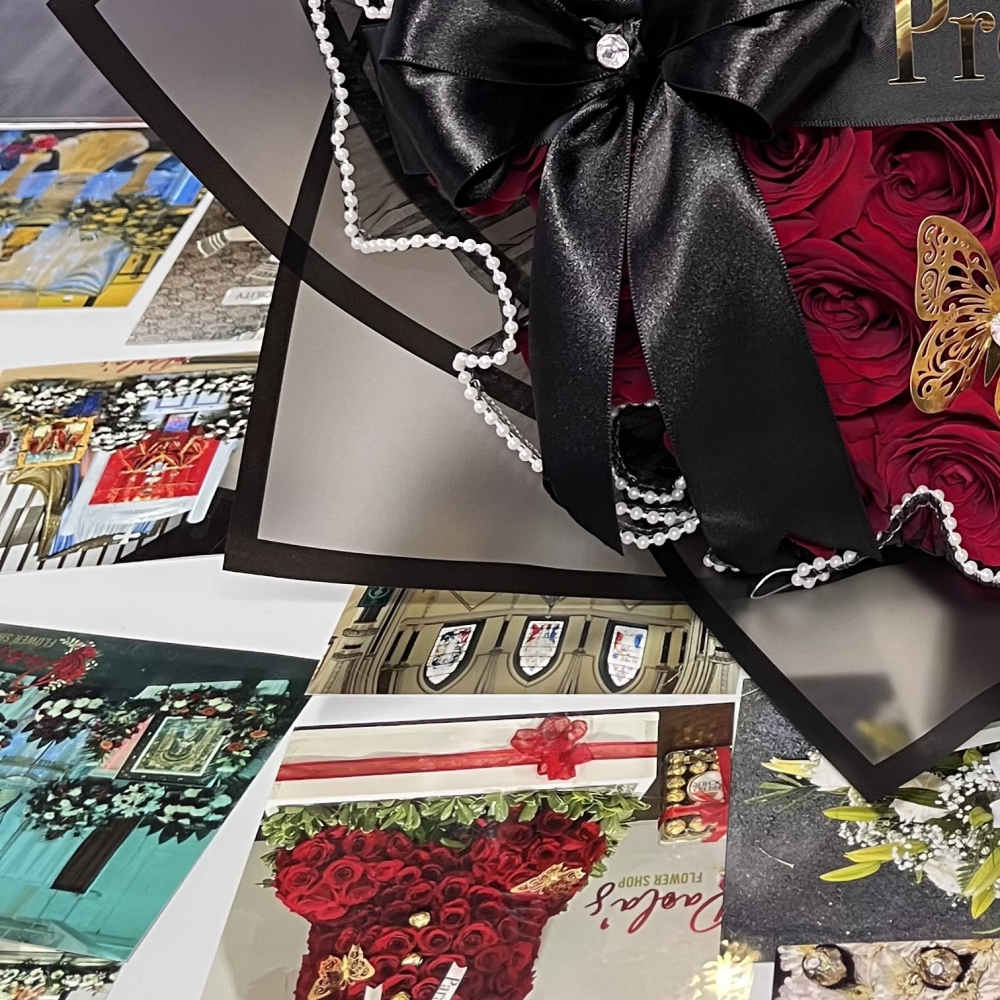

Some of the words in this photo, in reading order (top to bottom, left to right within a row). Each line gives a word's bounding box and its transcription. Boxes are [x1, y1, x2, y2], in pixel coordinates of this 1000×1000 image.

[617, 875, 652, 889] SHOP
[653, 871, 704, 886] FLOWER
[583, 881, 724, 934] Paola's
